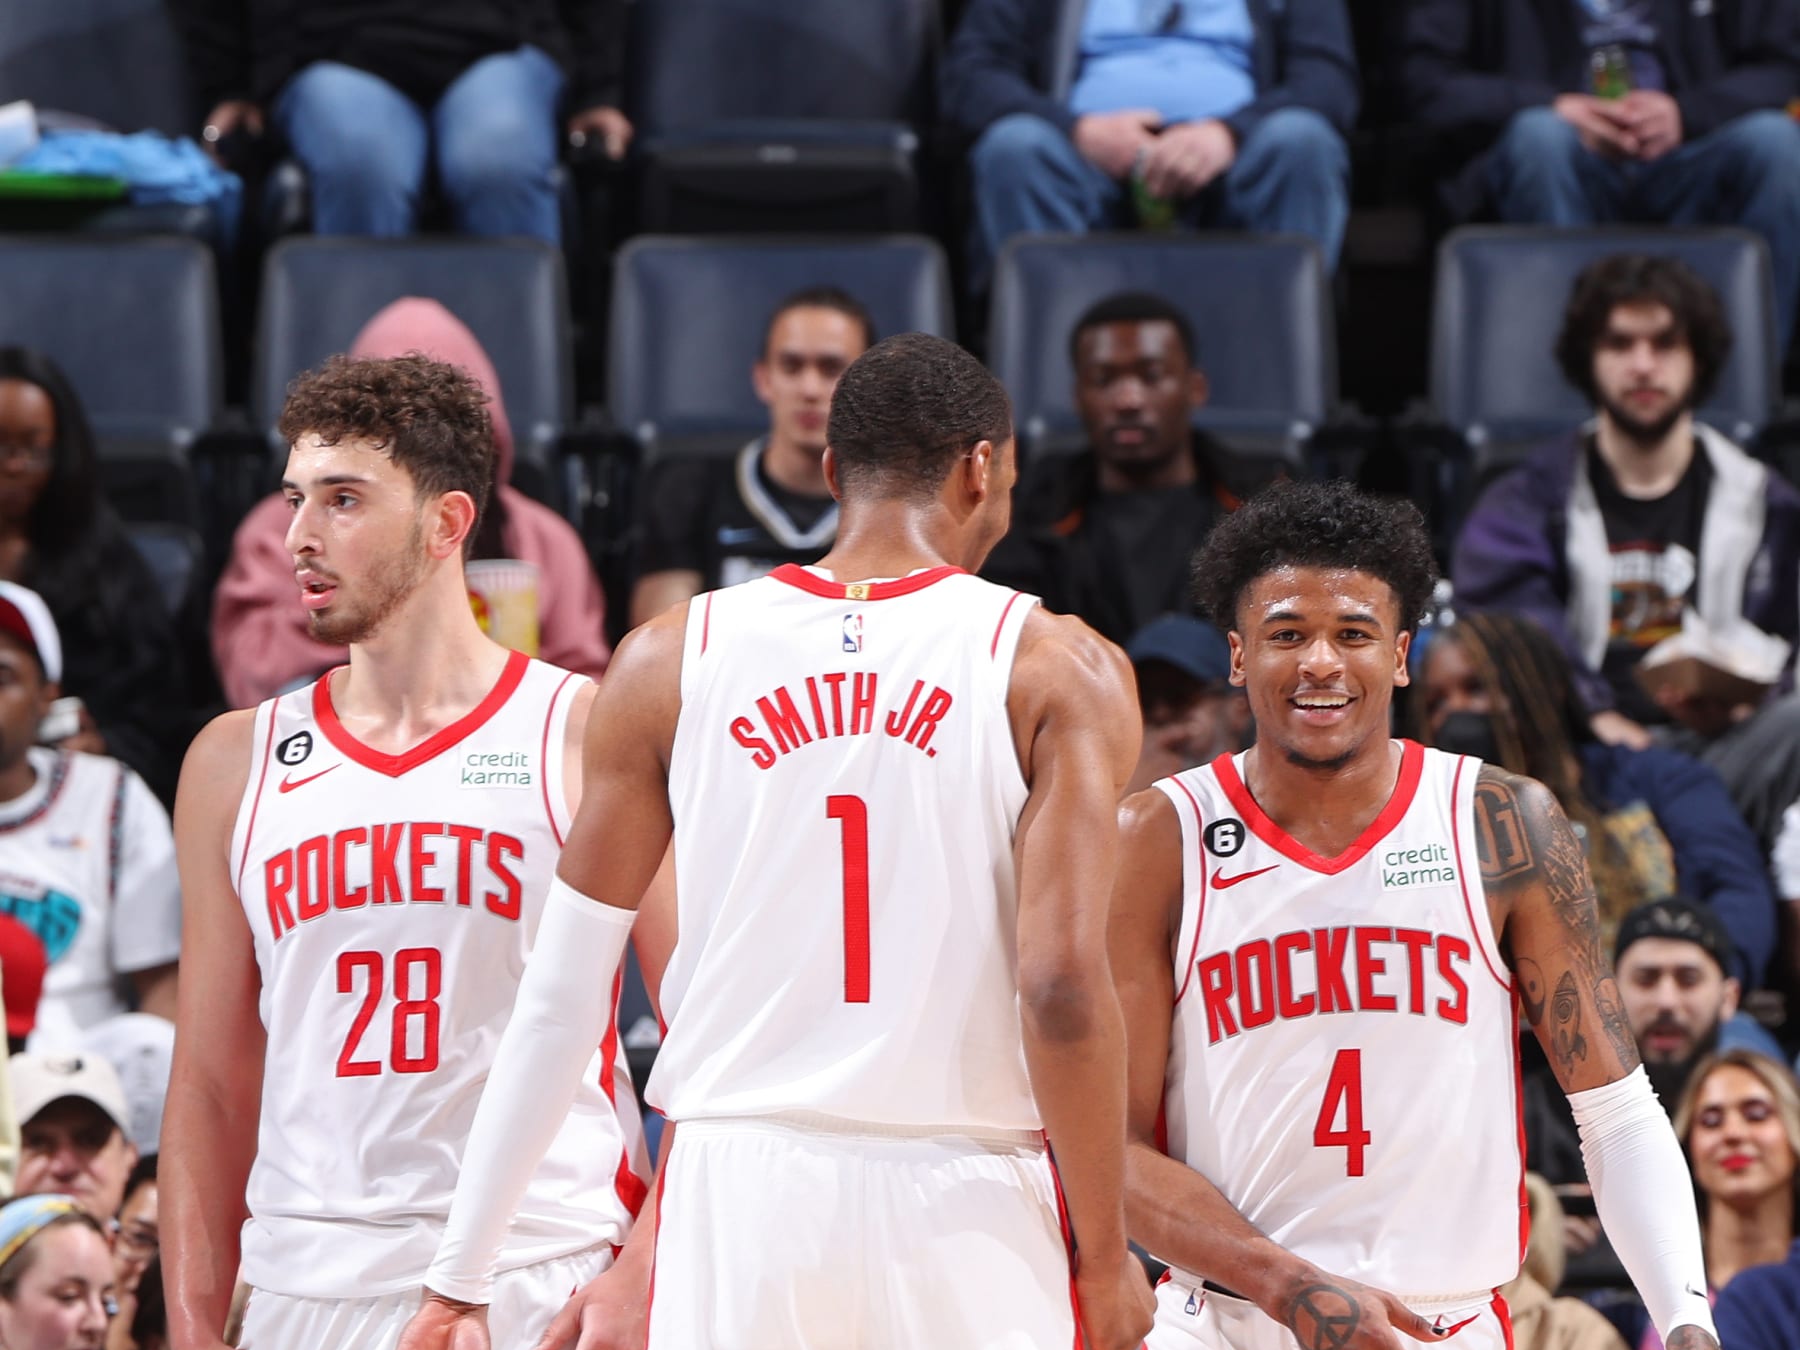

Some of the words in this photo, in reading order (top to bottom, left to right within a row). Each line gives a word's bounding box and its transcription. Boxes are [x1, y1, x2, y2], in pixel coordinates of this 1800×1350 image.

[281, 733, 310, 763] 6
[729, 672, 878, 770] SMITH
[884, 679, 953, 758] JR.
[461, 767, 531, 785] karma
[466, 752, 528, 767] credit
[1210, 821, 1239, 854] 6
[1385, 843, 1448, 866] credit
[264, 822, 525, 945] ROCKETS
[827, 795, 870, 1003] 1
[1383, 867, 1455, 888] karma
[336, 947, 442, 1077] 28
[1196, 925, 1471, 1047] ROCKETS
[1313, 1048, 1371, 1177] 4
